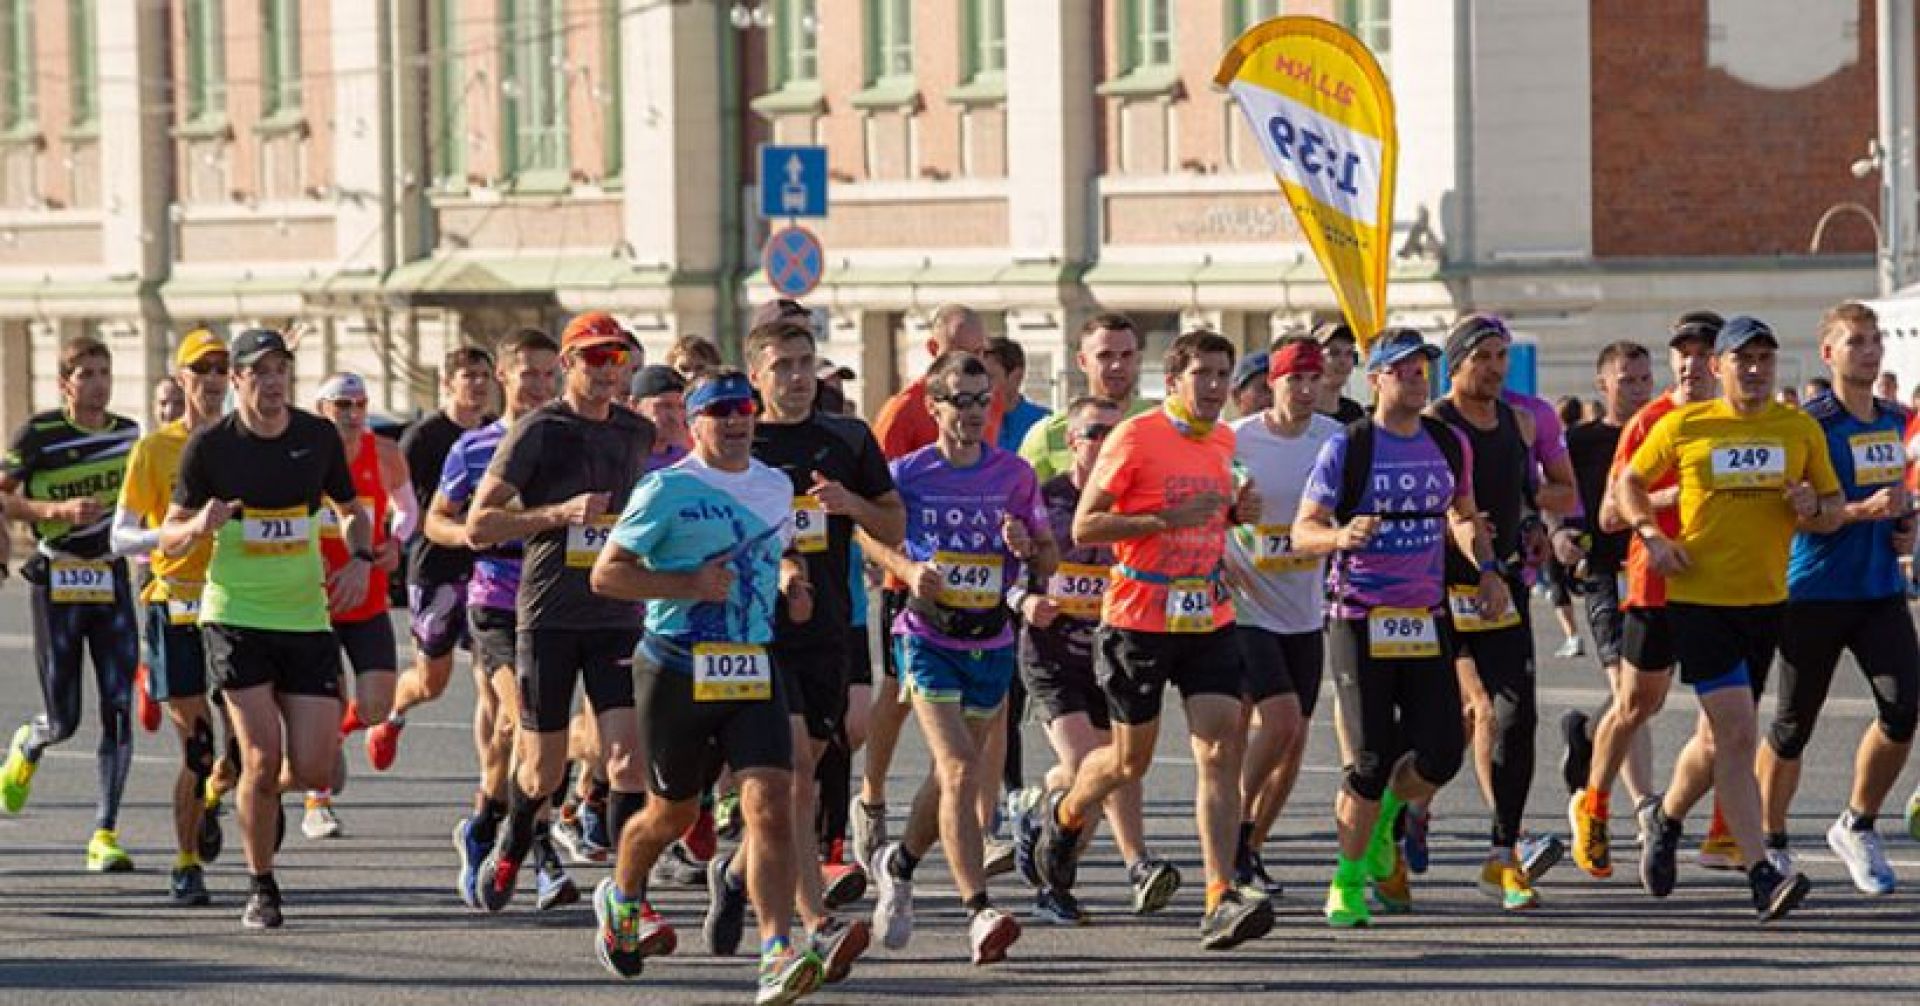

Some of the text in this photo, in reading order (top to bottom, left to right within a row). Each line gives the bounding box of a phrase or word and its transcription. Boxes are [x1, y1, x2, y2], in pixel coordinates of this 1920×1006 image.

[1728, 448, 1770, 468] 249
[261, 519, 294, 538] 711
[1267, 535, 1291, 553] 72
[60, 568, 104, 585] 1307
[948, 565, 990, 587] 649
[1062, 577, 1104, 595] 302
[1383, 617, 1425, 637] 989
[705, 654, 760, 677] 1021
